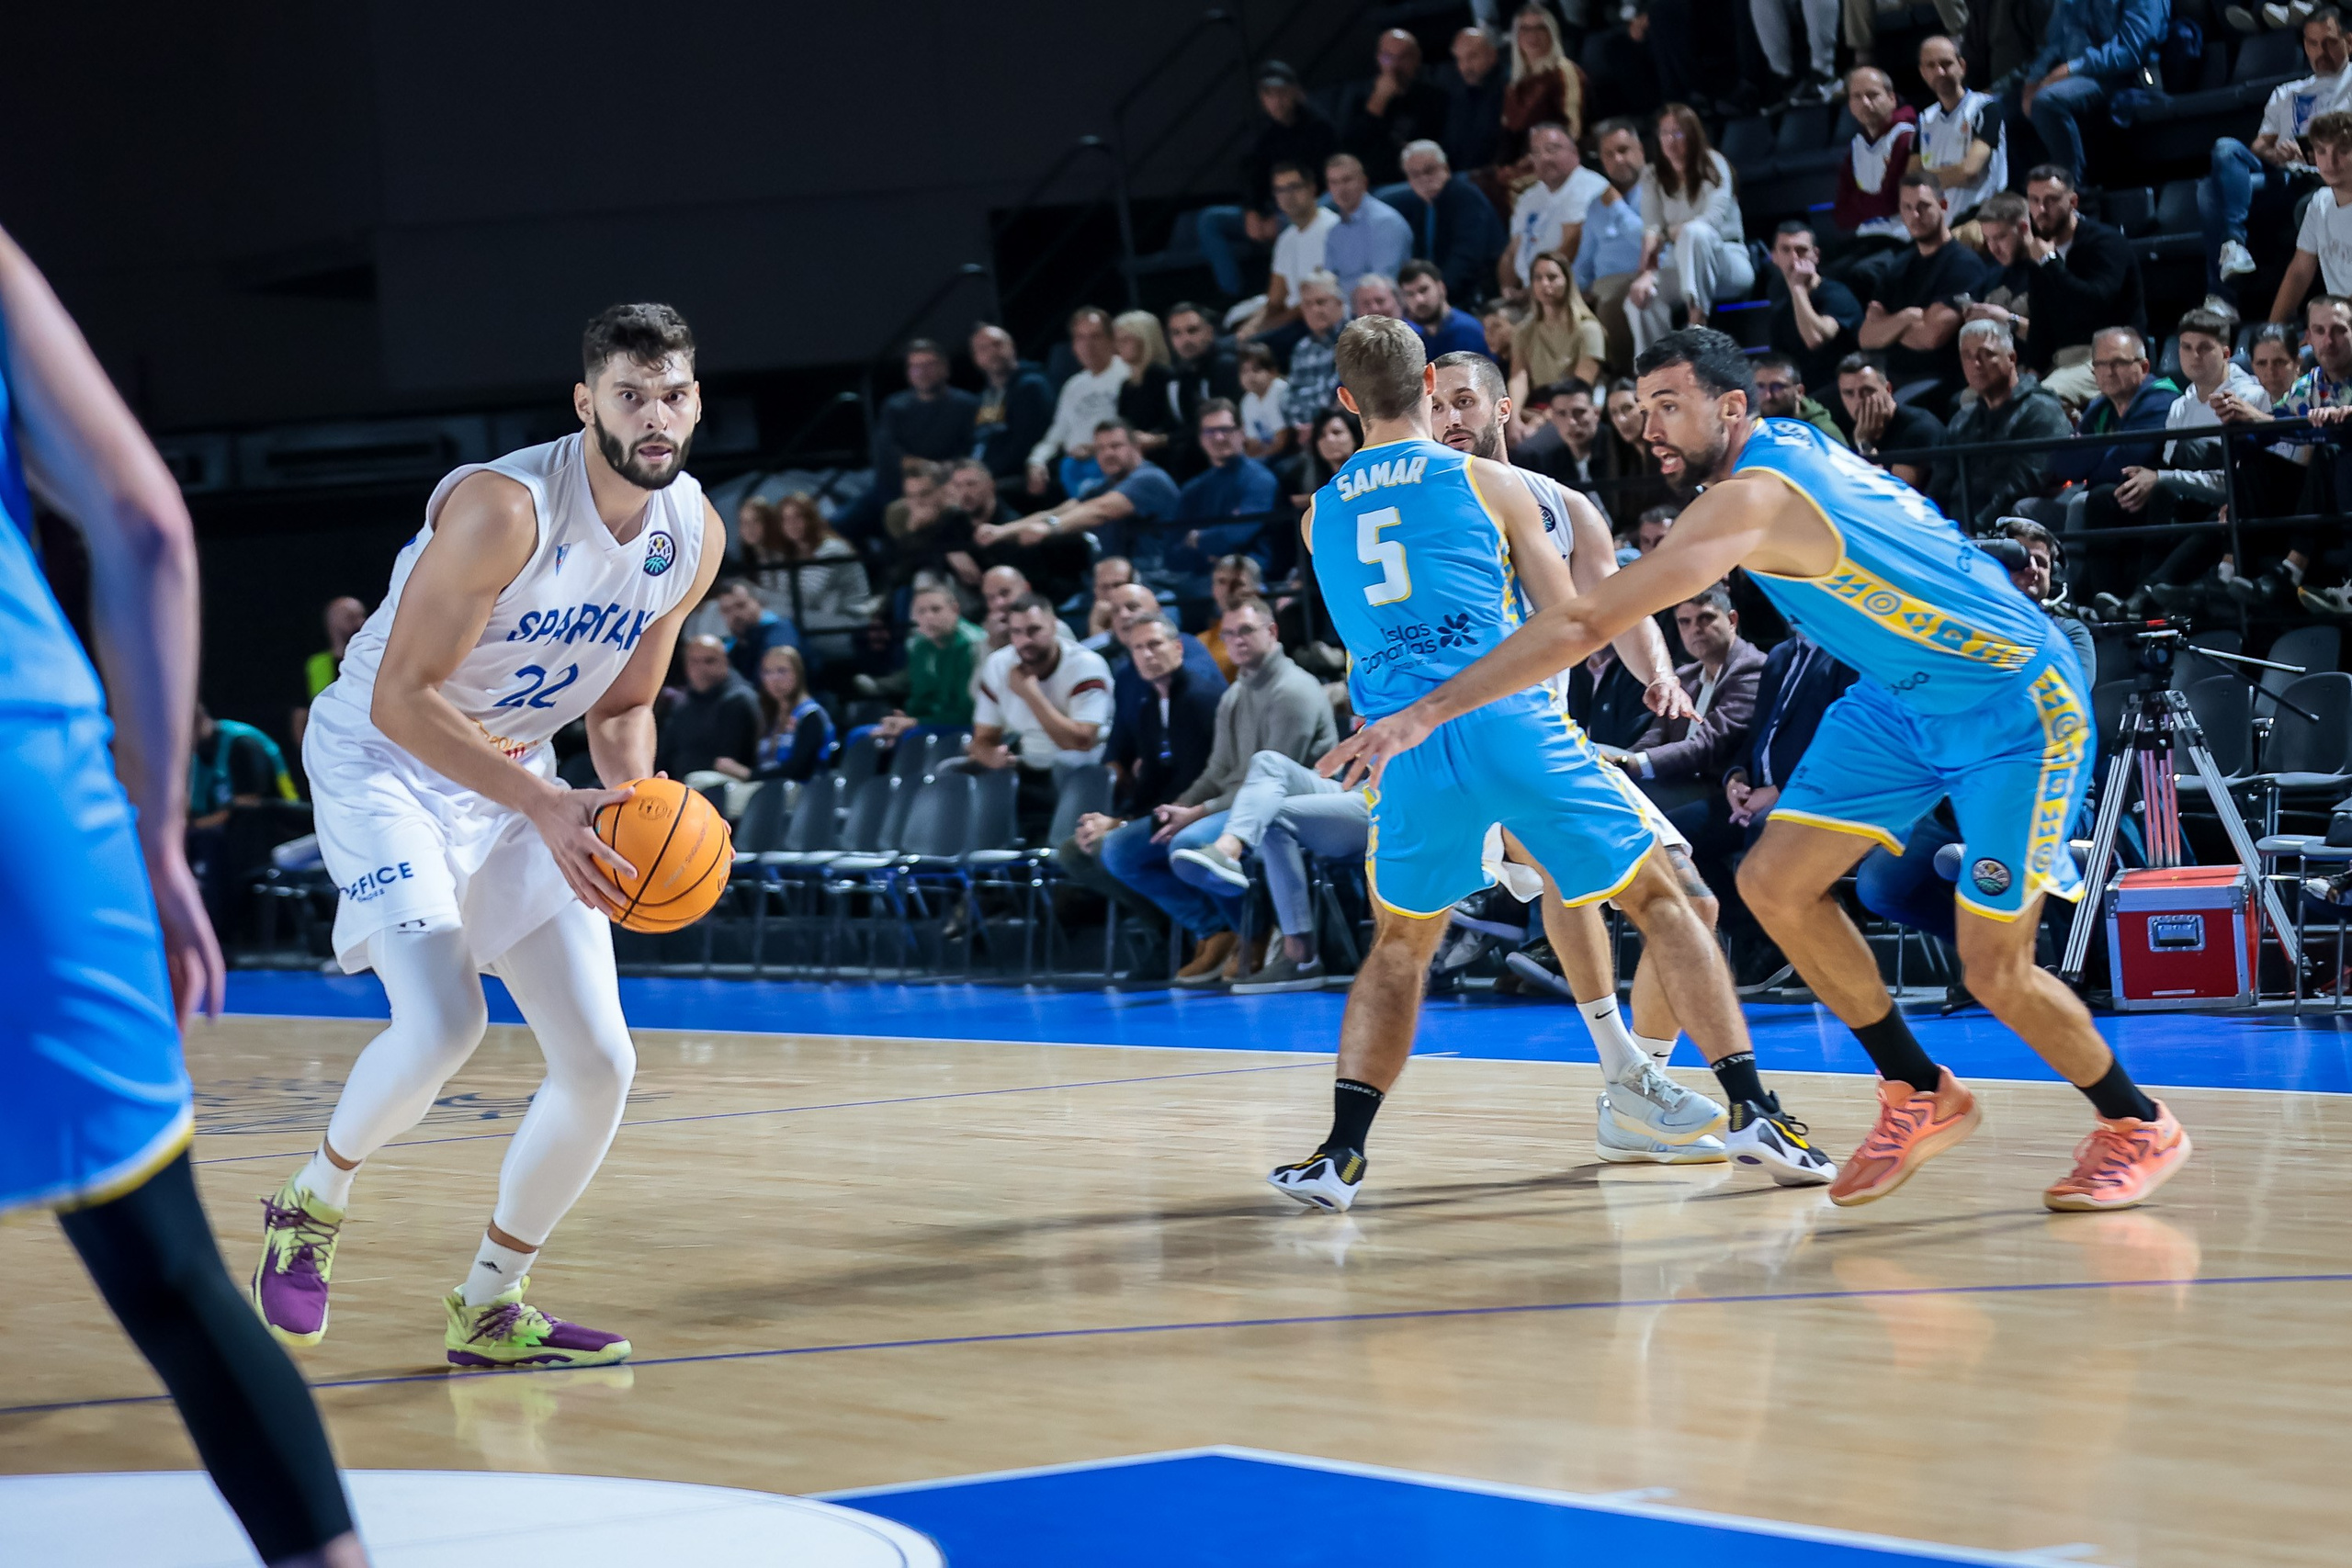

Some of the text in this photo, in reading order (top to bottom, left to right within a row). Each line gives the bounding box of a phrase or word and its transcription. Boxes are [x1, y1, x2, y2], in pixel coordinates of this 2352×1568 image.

[1336, 456, 1429, 502] SAMAR
[1356, 505, 1413, 607] 5
[492, 662, 579, 709] 22
